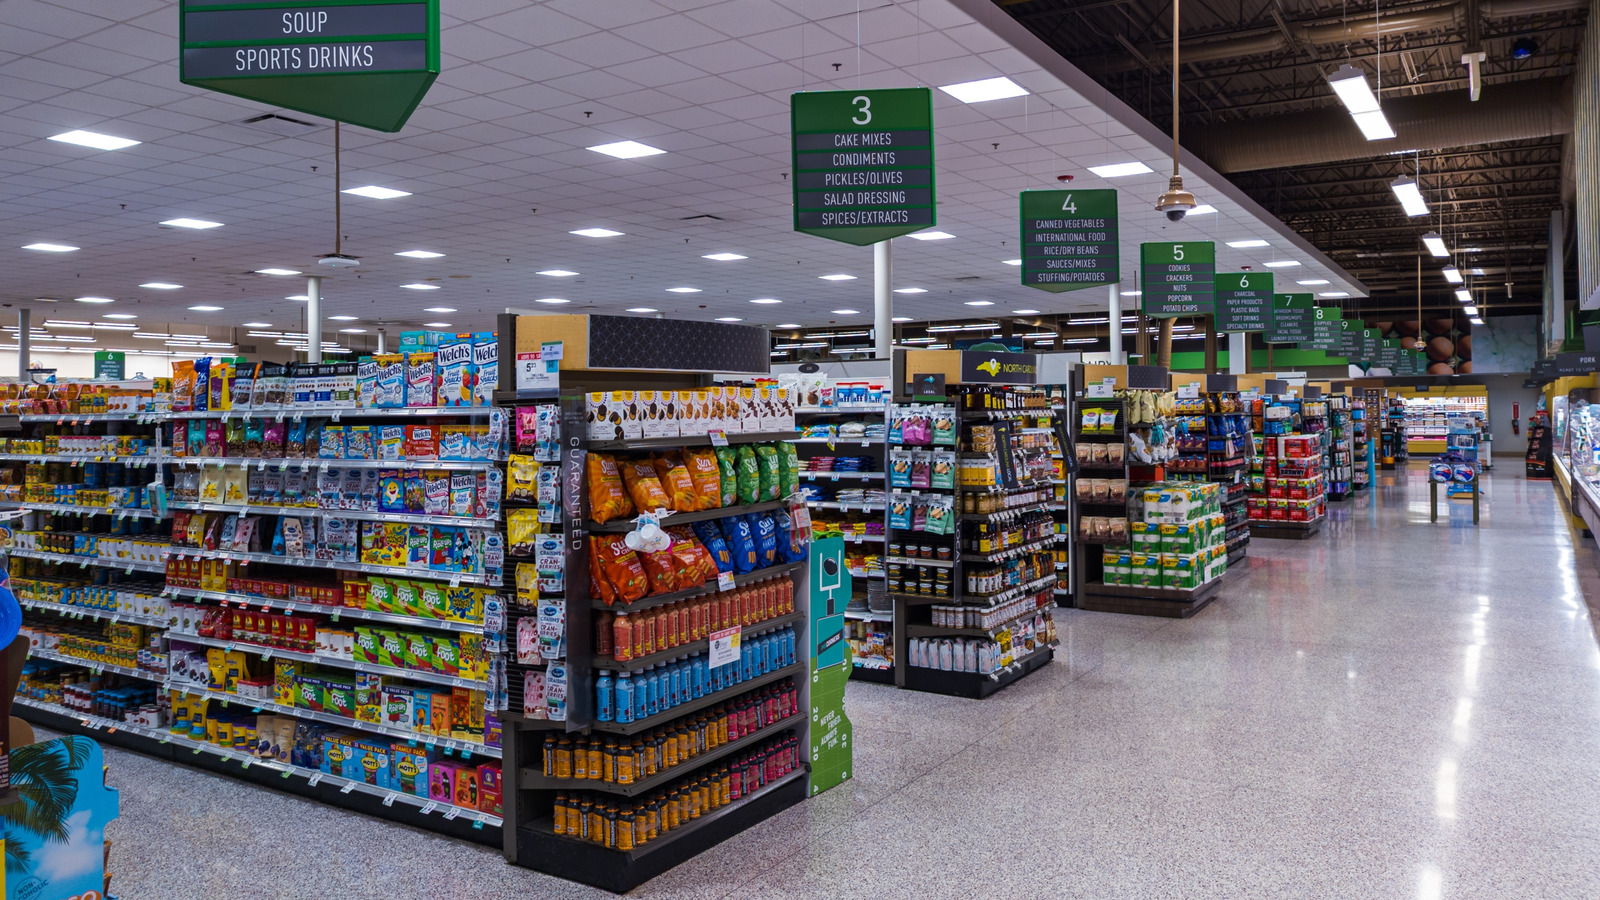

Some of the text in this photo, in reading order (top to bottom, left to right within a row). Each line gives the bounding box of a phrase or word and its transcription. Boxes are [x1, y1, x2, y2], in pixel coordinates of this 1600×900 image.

[283, 12, 327, 33] SOUP
[236, 46, 373, 70] SPORTS DRINKS
[852, 96, 872, 125] 3
[835, 133, 891, 146] CAKE MIXES
[833, 152, 895, 166] CONDIMENTS
[826, 172, 902, 186] PICKLES/OLIVES
[824, 191, 905, 205] SALAD DRESSING
[1062, 194, 1077, 214] 4
[822, 211, 908, 225] SPICES/EXTRACTS
[1036, 219, 1104, 228] CANNED VEGETABLES
[1036, 233, 1105, 242] INTERNATIONAL FOOD
[1044, 246, 1098, 255] RICE/DRY BEANS
[1174, 245, 1184, 260] 5
[1047, 259, 1096, 268] SAUCES/MIXES
[1038, 273, 1104, 282] STUFFING/POTATOES
[1240, 275, 1249, 288] 6
[1285, 296, 1292, 306] 7
[1316, 310, 1323, 319] 8
[1342, 321, 1348, 329] 9
[439, 346, 470, 362] Welch's
[378, 365, 402, 380] Welch's
[410, 364, 431, 380] Welch's
[1003, 364, 1022, 373] NORTH
[383, 428, 401, 437] Welch's
[413, 430, 431, 438] Welch's
[601, 460, 615, 474] Sun
[635, 465, 653, 476] Sun
[696, 458, 711, 470] Sun
[426, 480, 447, 493] Welch's
[570, 436, 582, 551] GUARANTEED
[759, 517, 774, 535] Sun
[821, 710, 834, 727] NEVER
[821, 727, 837, 746] ALWAYS
[18, 881, 36, 895] NON-
